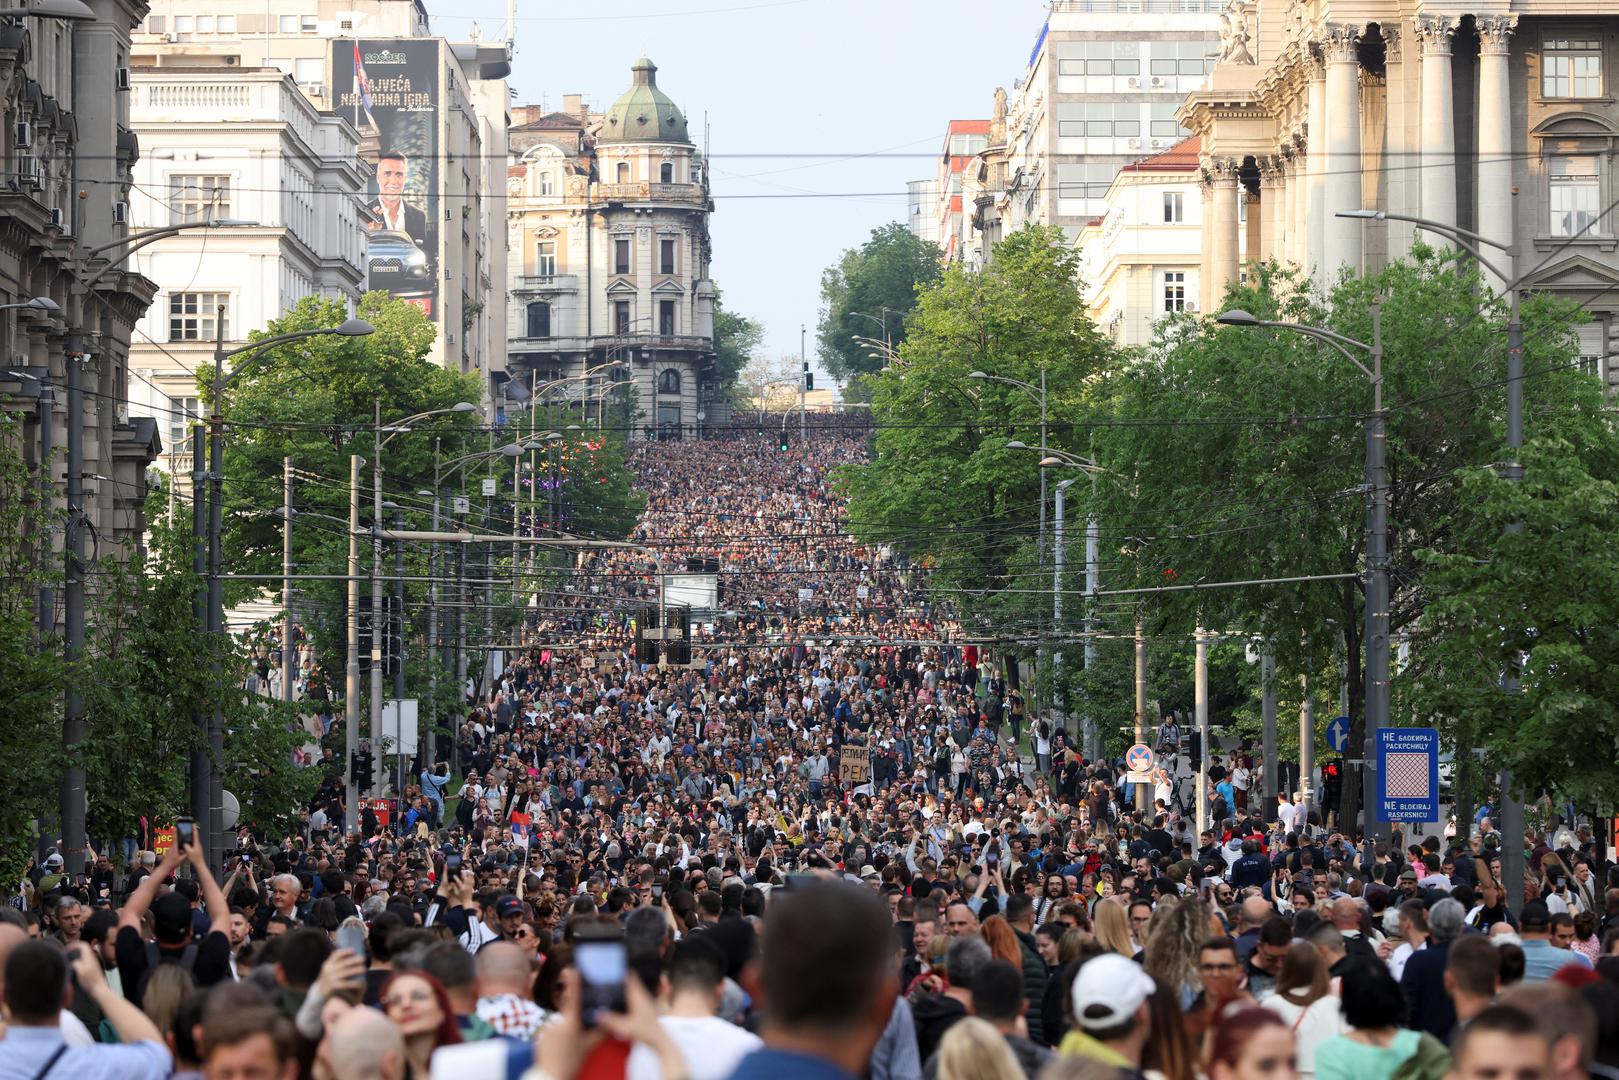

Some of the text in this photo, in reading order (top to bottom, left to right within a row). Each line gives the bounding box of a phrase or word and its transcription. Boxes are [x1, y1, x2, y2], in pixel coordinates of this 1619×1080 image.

[367, 74, 411, 92] AJVEĆA
[403, 93, 430, 106] IGRA
[1382, 732, 1396, 742] НЕ
[1384, 801, 1397, 810] NE
